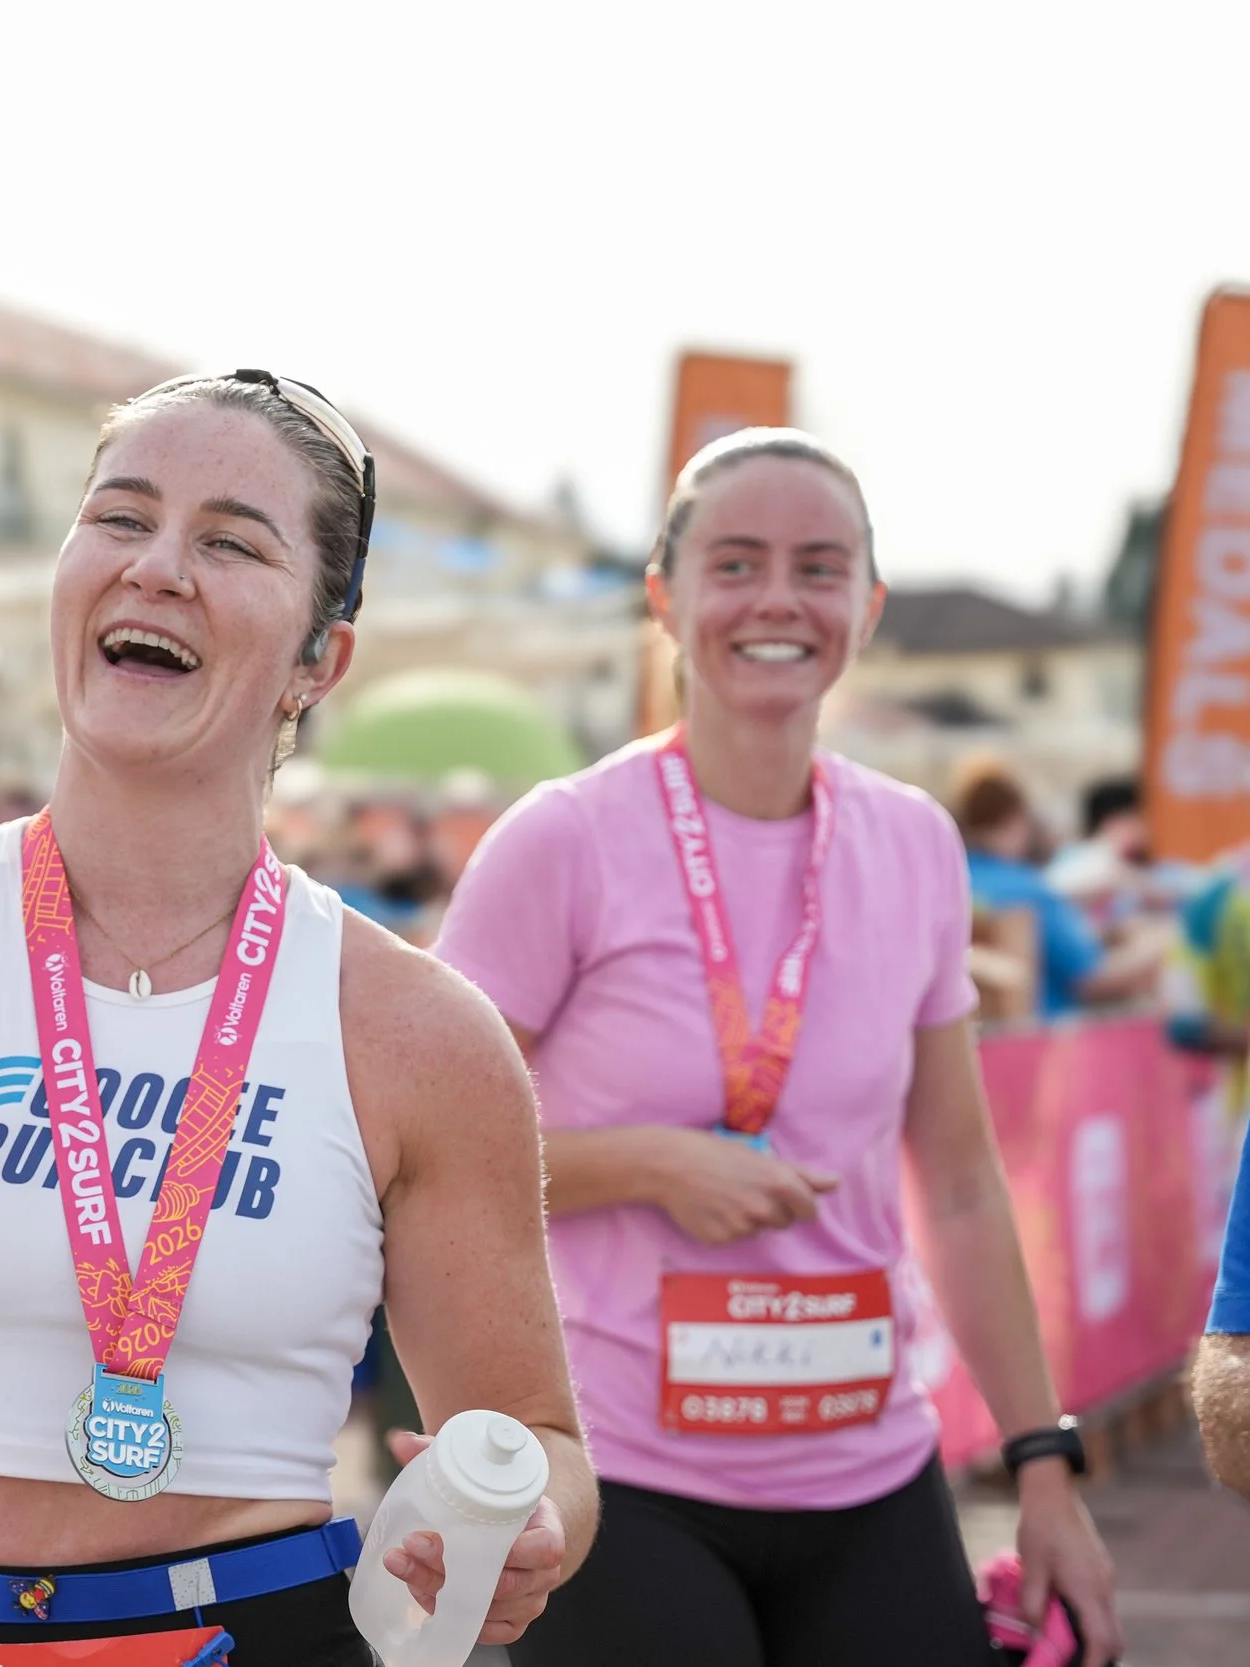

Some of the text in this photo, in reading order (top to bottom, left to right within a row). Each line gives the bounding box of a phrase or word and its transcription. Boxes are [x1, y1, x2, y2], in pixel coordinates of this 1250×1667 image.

[223, 972, 253, 1028] Voltaren
[49, 972, 112, 1246] Voltaren CITY2SURF
[144, 1217, 203, 1266] 2026
[114, 1402, 154, 1417] Voltaren
[89, 1416, 165, 1448] CITY2
[91, 1440, 160, 1468] SURF
